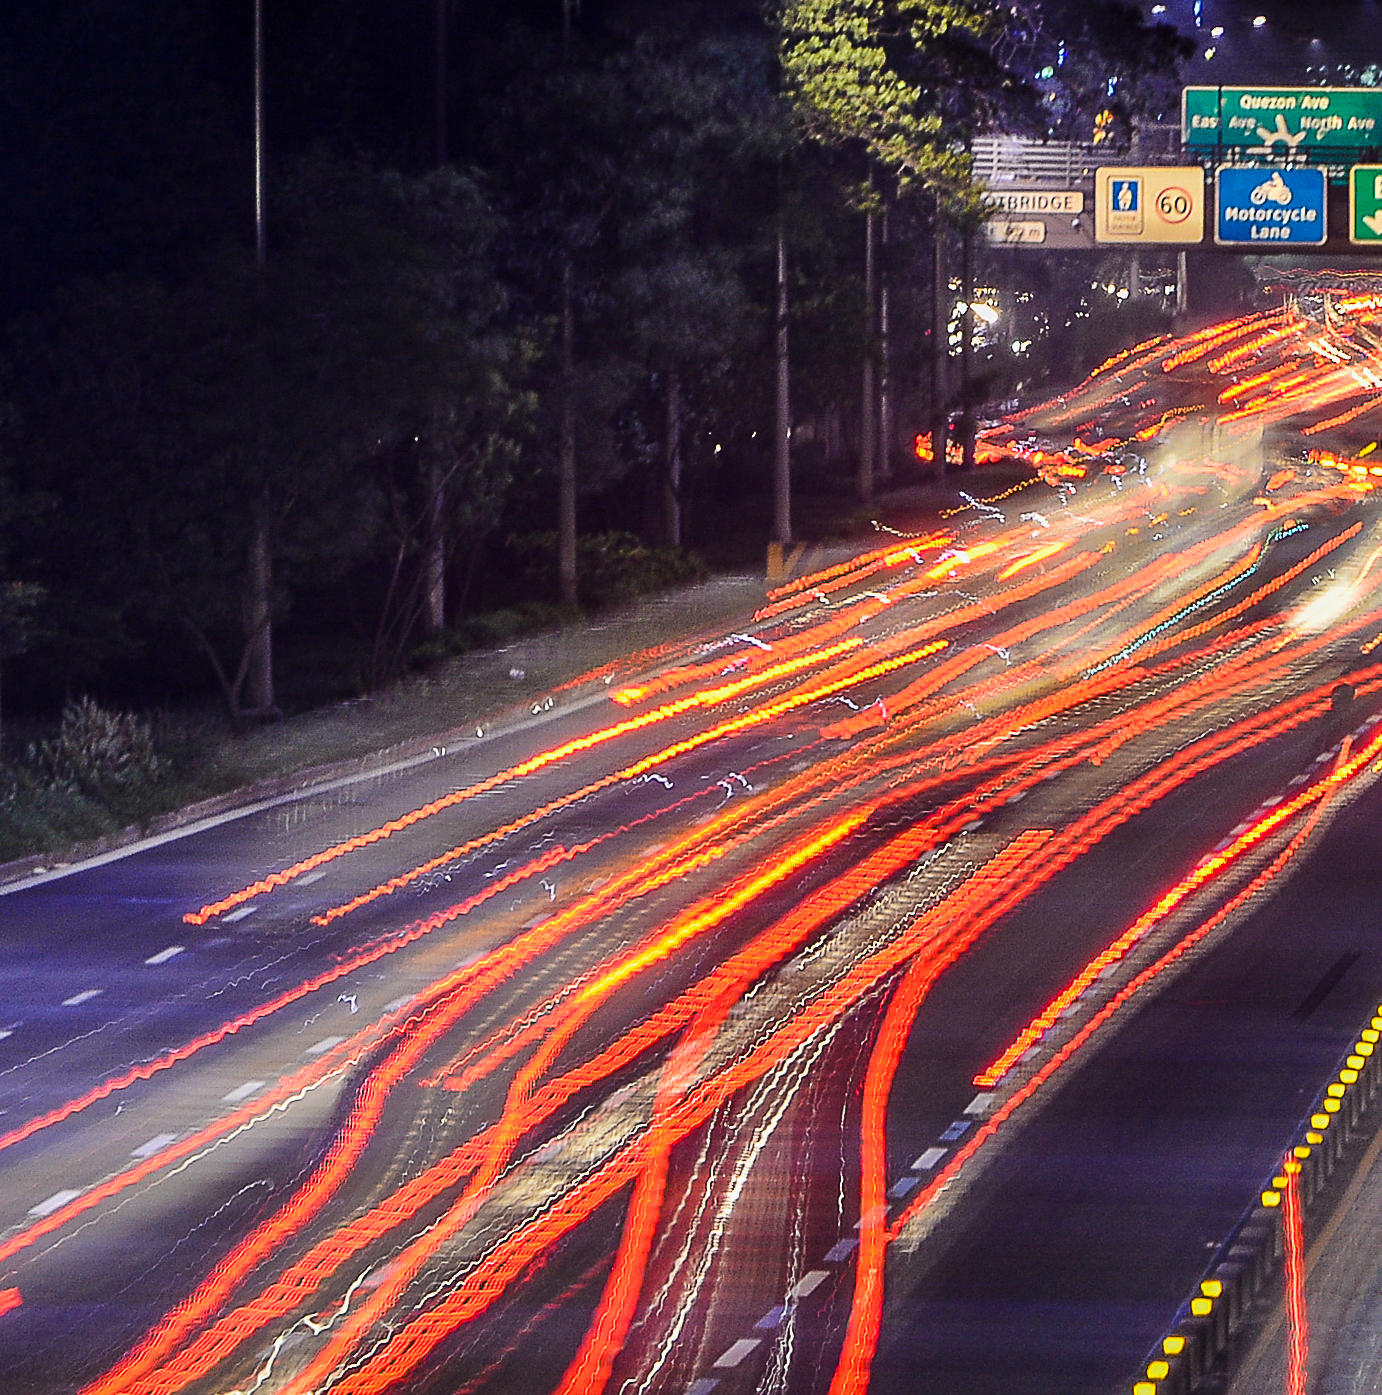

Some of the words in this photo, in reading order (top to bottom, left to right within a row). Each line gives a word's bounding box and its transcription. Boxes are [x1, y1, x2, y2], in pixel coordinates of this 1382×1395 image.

[1240, 94, 1296, 110] Quezon
[1301, 95, 1329, 110] Ave
[1192, 114, 1220, 129] Eas
[1228, 115, 1256, 129] Ave
[1300, 115, 1342, 130] North
[1348, 116, 1375, 130] Ave
[1161, 196, 1187, 215] 60
[1225, 207, 1317, 224] Motorcycle
[1250, 225, 1290, 239] Lane
